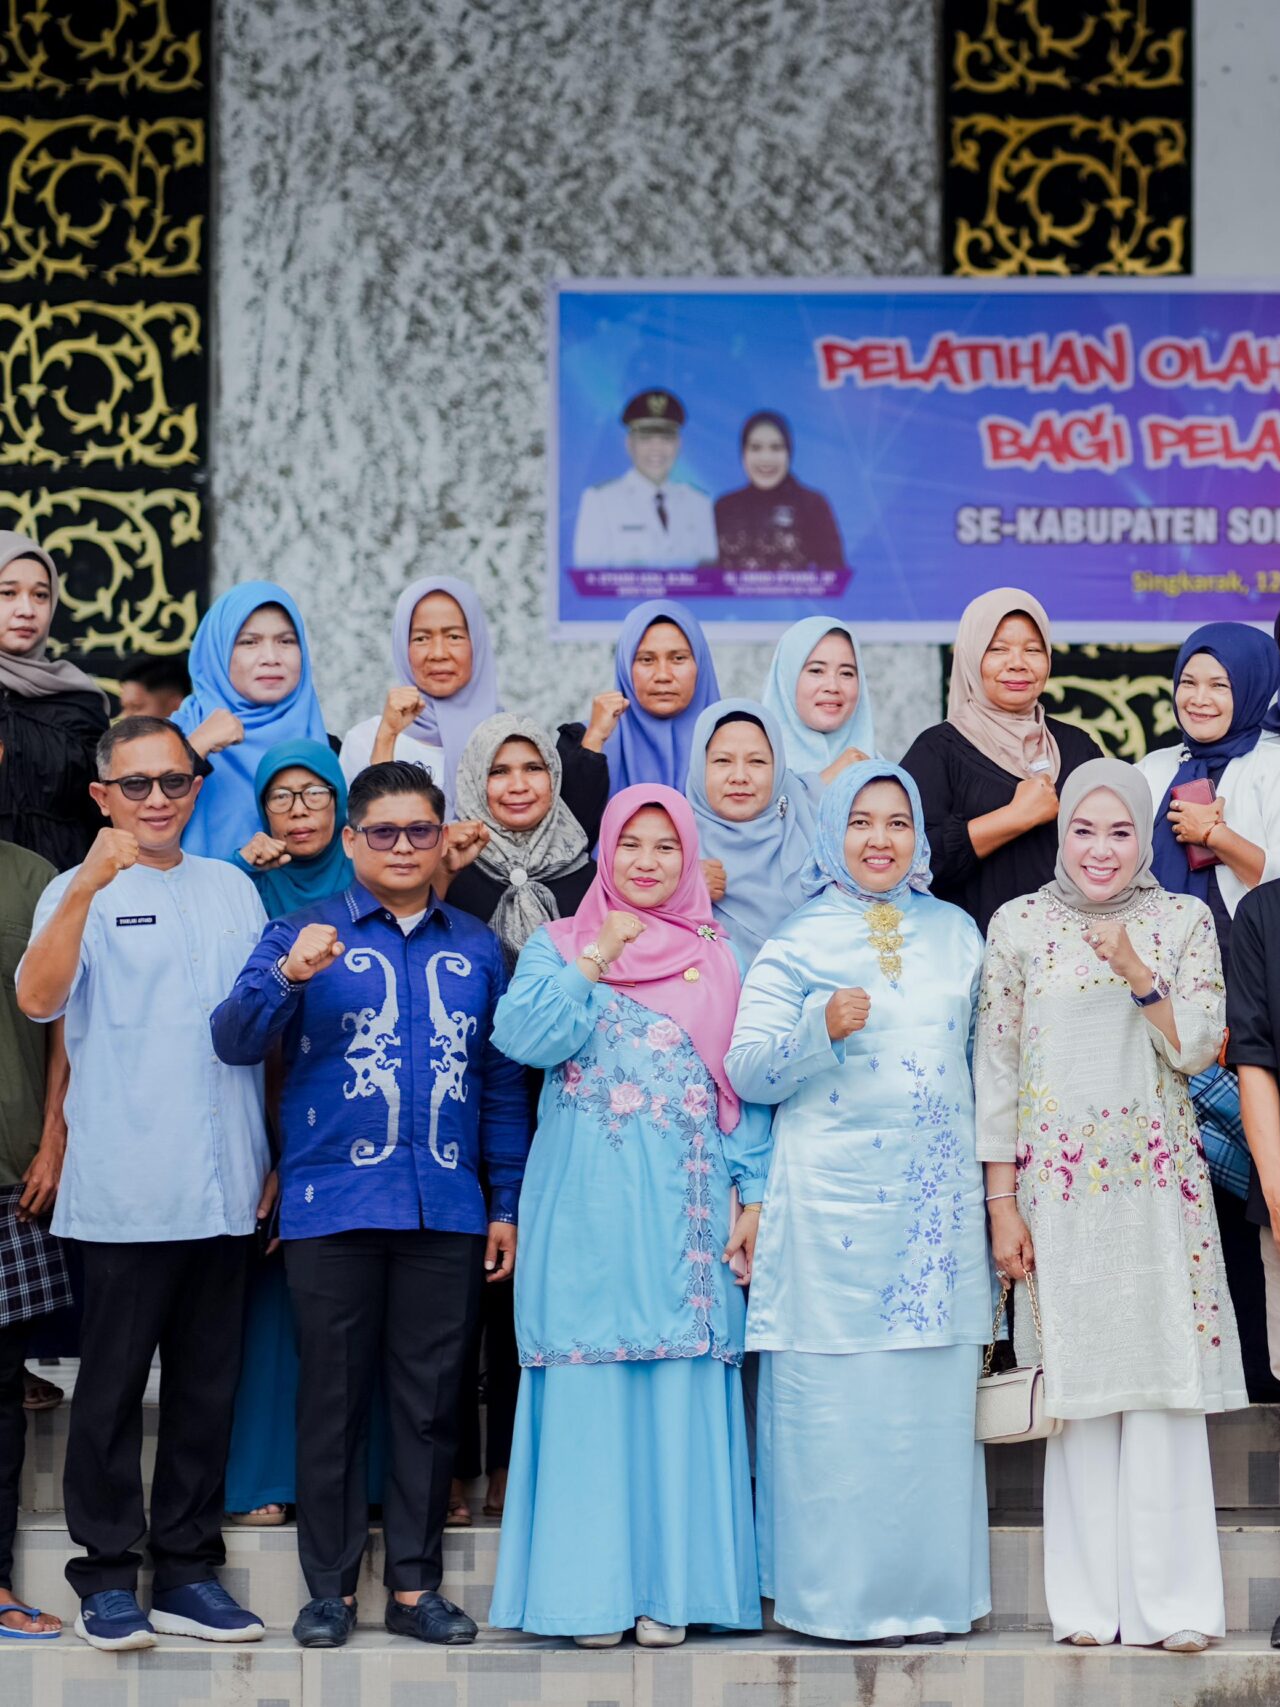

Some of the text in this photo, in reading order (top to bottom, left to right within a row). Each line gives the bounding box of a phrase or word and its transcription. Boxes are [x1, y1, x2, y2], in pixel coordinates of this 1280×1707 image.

[816, 325, 1133, 393] PELATIHAN
[979, 404, 1133, 474] BAGI
[956, 508, 1217, 544] SE-KABUPATEN
[1132, 570, 1249, 598] Singkarak,
